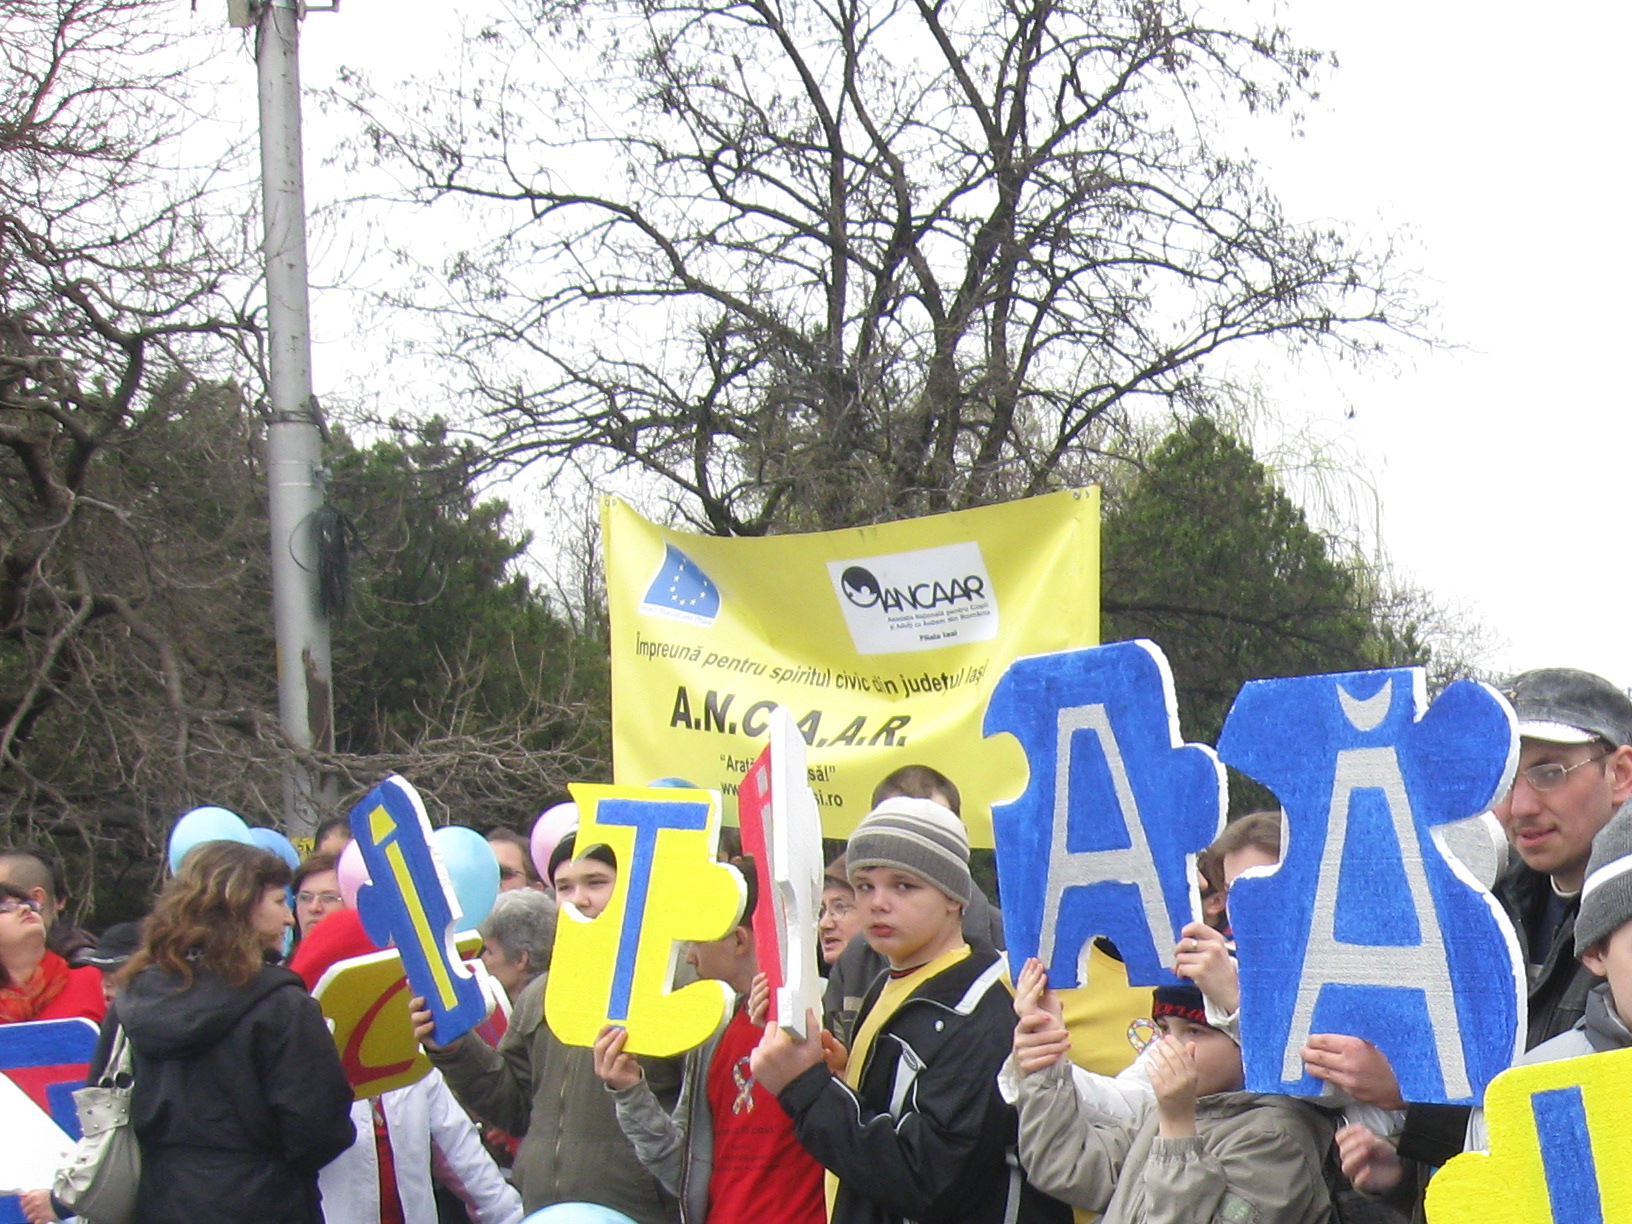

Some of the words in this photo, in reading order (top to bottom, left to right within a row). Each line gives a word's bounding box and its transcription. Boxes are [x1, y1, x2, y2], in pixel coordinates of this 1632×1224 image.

[879, 575, 985, 613] ANCAAR
[636, 631, 704, 662] Împreună
[701, 652, 768, 676] pentru
[769, 665, 831, 688] spiritul
[835, 670, 871, 692] civic
[873, 677, 899, 695] din
[669, 685, 912, 748] A.N.CA.A.R.
[1037, 703, 1178, 970] A
